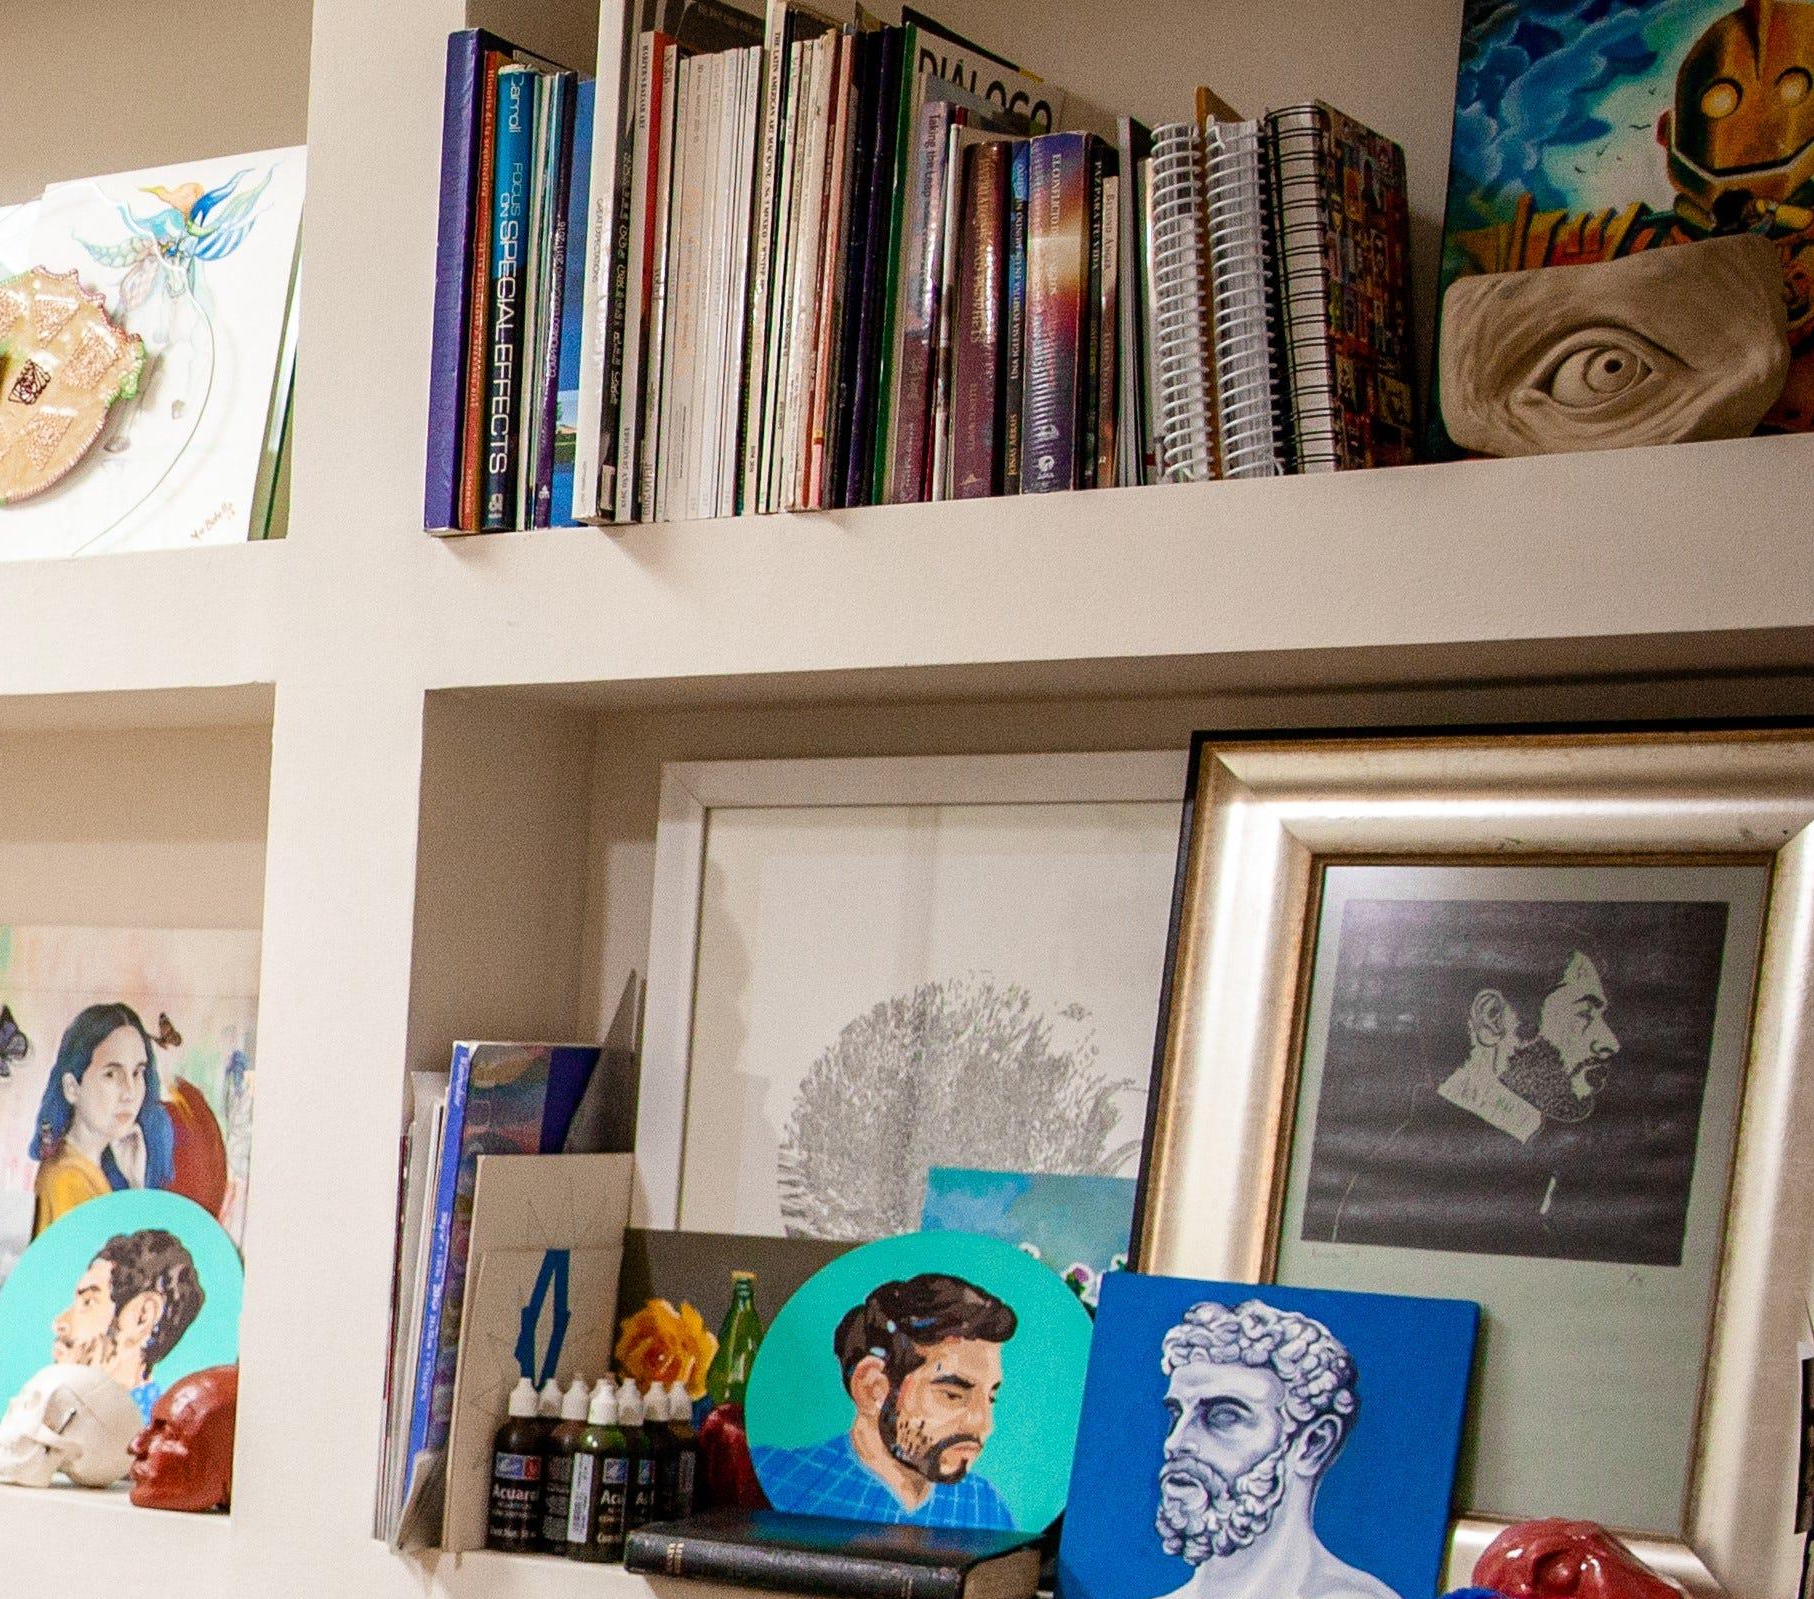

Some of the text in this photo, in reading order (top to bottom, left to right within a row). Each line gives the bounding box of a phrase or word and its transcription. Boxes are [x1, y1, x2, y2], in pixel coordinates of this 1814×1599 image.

[771, 50, 780, 73] LATIN
[768, 75, 778, 116] AMERICAN
[768, 119, 776, 133] ART
[926, 114, 941, 149] Taking
[925, 151, 937, 170] the
[511, 162, 524, 216] FOCUS
[922, 171, 936, 198] Leap
[499, 193, 510, 217] ON
[1092, 161, 1103, 270] PAZ PARA TU VIDA
[1104, 193, 1115, 270] BEYOND ANGER
[493, 220, 519, 340] SPECIAL
[489, 344, 513, 474] EFFECTS
